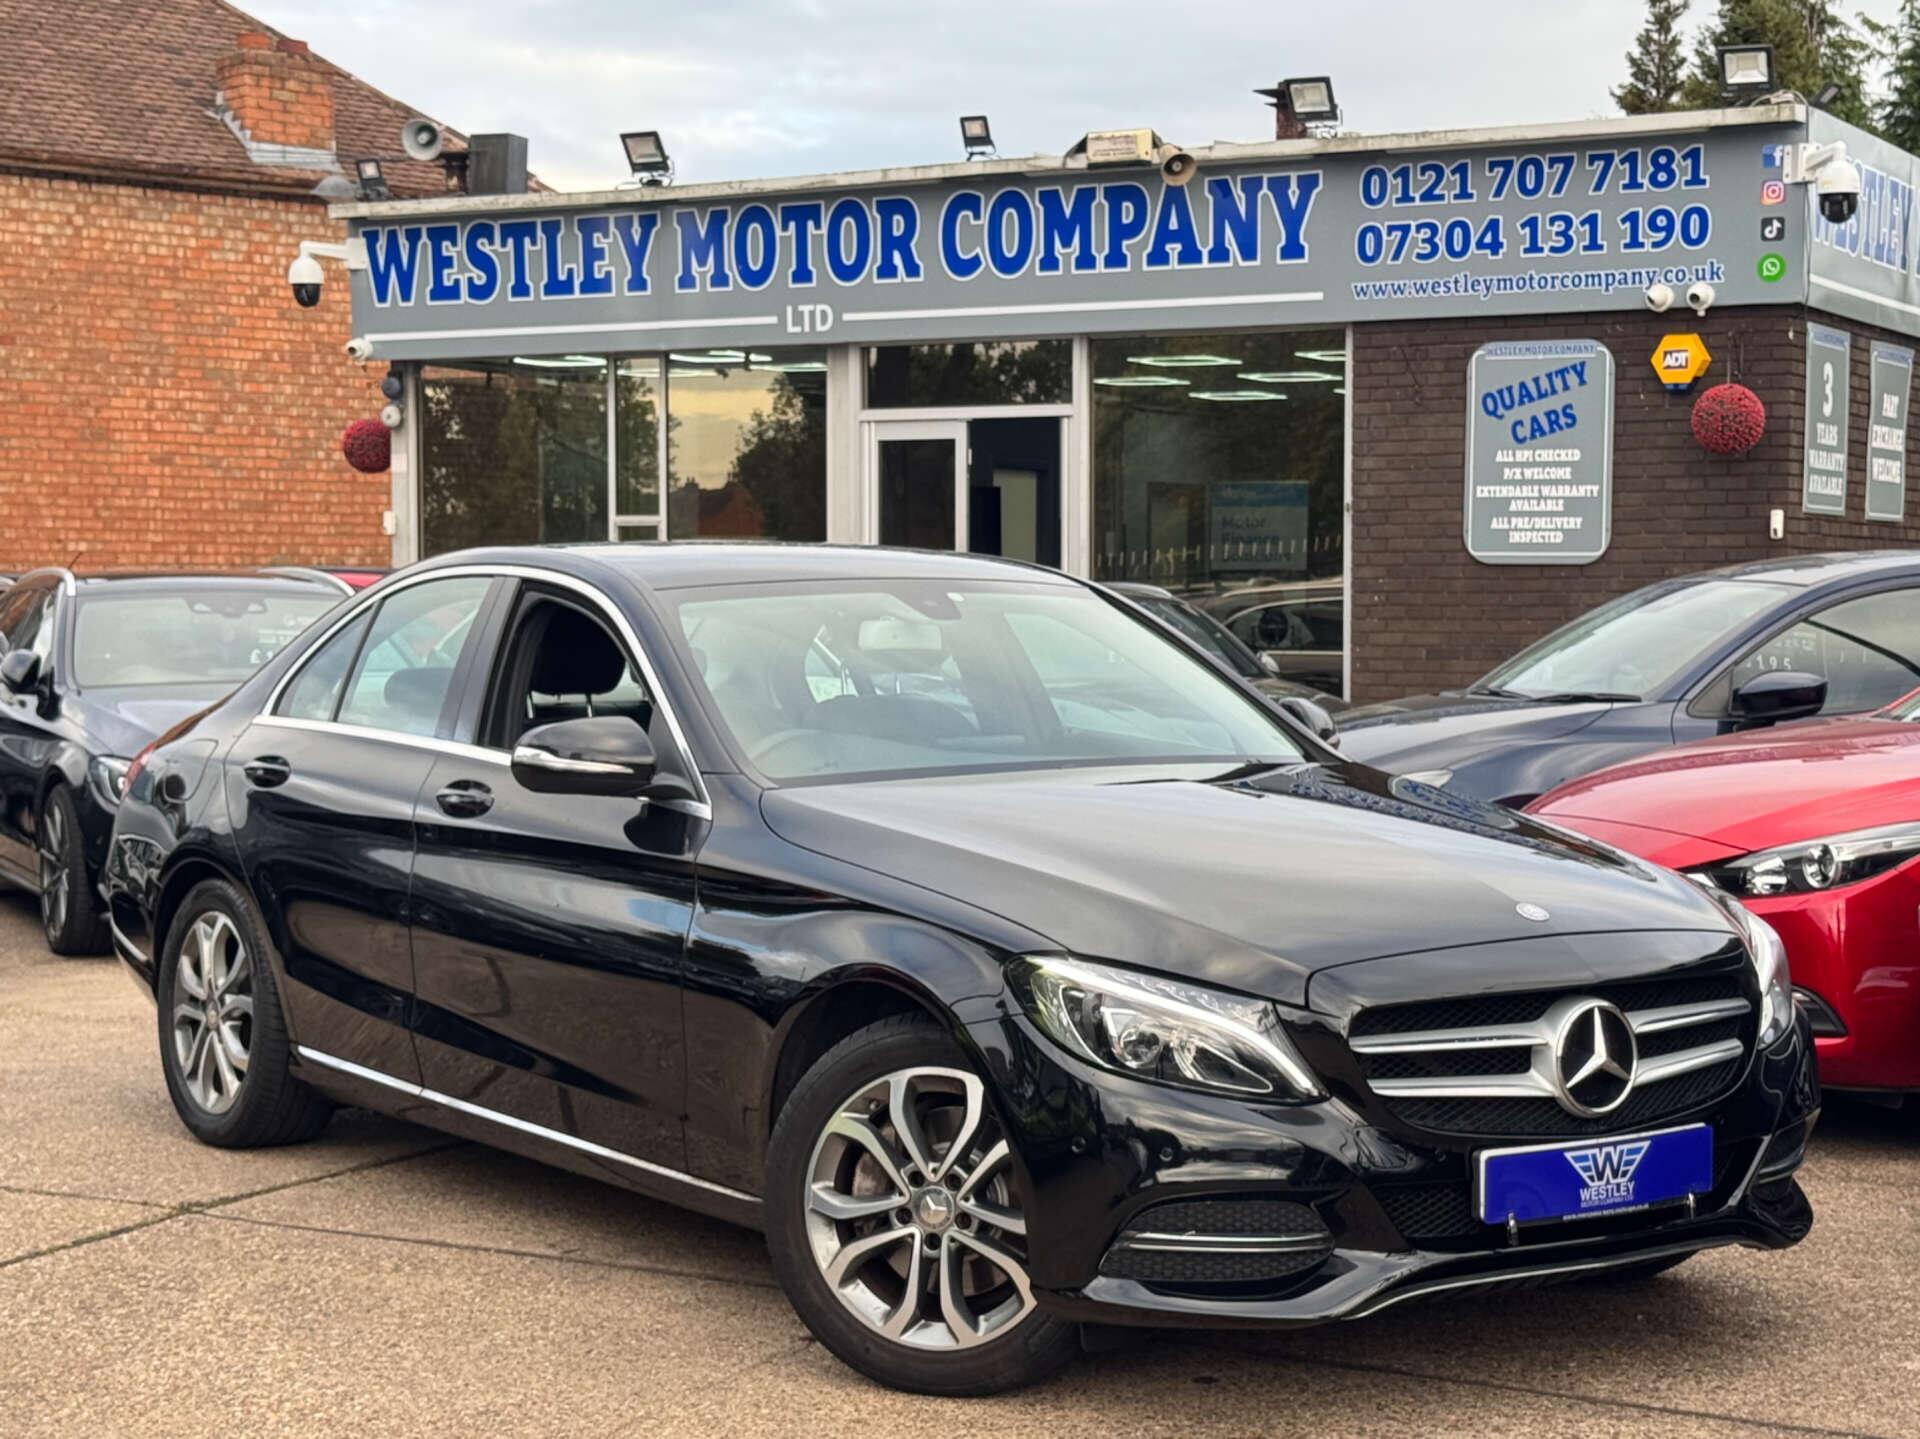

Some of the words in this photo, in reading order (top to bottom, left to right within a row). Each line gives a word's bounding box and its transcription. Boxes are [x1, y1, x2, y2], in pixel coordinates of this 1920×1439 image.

[1360, 159, 1475, 208] 0121
[1487, 153, 1575, 200] 707
[1587, 144, 1709, 194] 7181
[360, 211, 660, 307] WESTLEY
[674, 196, 924, 293] MOTOR
[939, 170, 1323, 281] COMPANY
[1355, 216, 1504, 265] 07304
[1518, 211, 1605, 258] 131
[1619, 203, 1711, 252] 190
[1352, 260, 1724, 300] www.westleymotorcompany.co.uk
[785, 303, 834, 334] LTD
[1662, 351, 1689, 368] ADT
[1481, 361, 1587, 420] QUALITY
[1822, 361, 1834, 417] 3
[1511, 403, 1577, 444] CARS
[1495, 449, 1514, 462] ALL
[1515, 449, 1534, 462] HPI
[1534, 448, 1581, 462] CHECKED
[1503, 467, 1522, 480] P/X
[1523, 467, 1572, 480] WELCOME
[1476, 485, 1539, 498] EXTENDABLE
[1540, 484, 1600, 497] WARRANTY
[1509, 499, 1564, 511] AVAILABLE
[1490, 517, 1509, 529] ALL
[1510, 517, 1583, 529] PRE/DELIVERY
[1509, 531, 1564, 543] INSPECTED
[1580, 1181, 1635, 1201] WESTLEY
